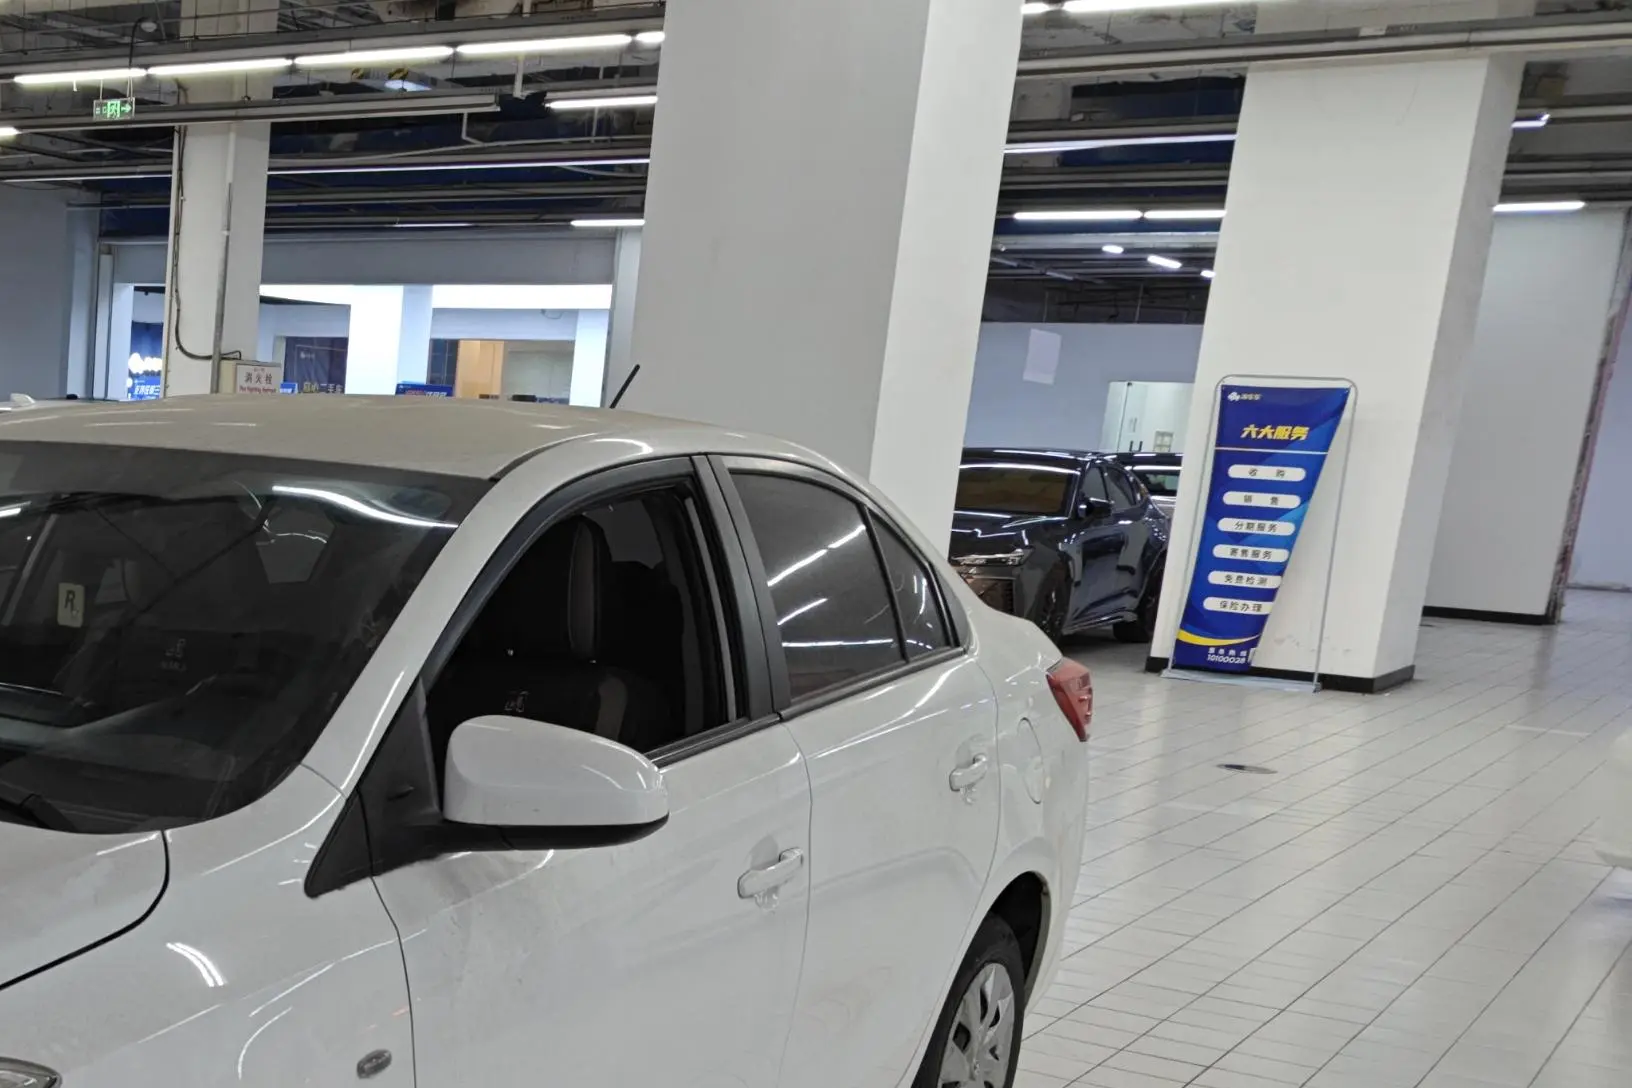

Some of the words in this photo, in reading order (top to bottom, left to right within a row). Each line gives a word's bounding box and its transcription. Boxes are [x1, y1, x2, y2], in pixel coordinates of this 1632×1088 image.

[1240, 424, 1310, 440] 六大服务
[1234, 521, 1277, 532] 分期服务
[1219, 600, 1262, 612] 保险办理
